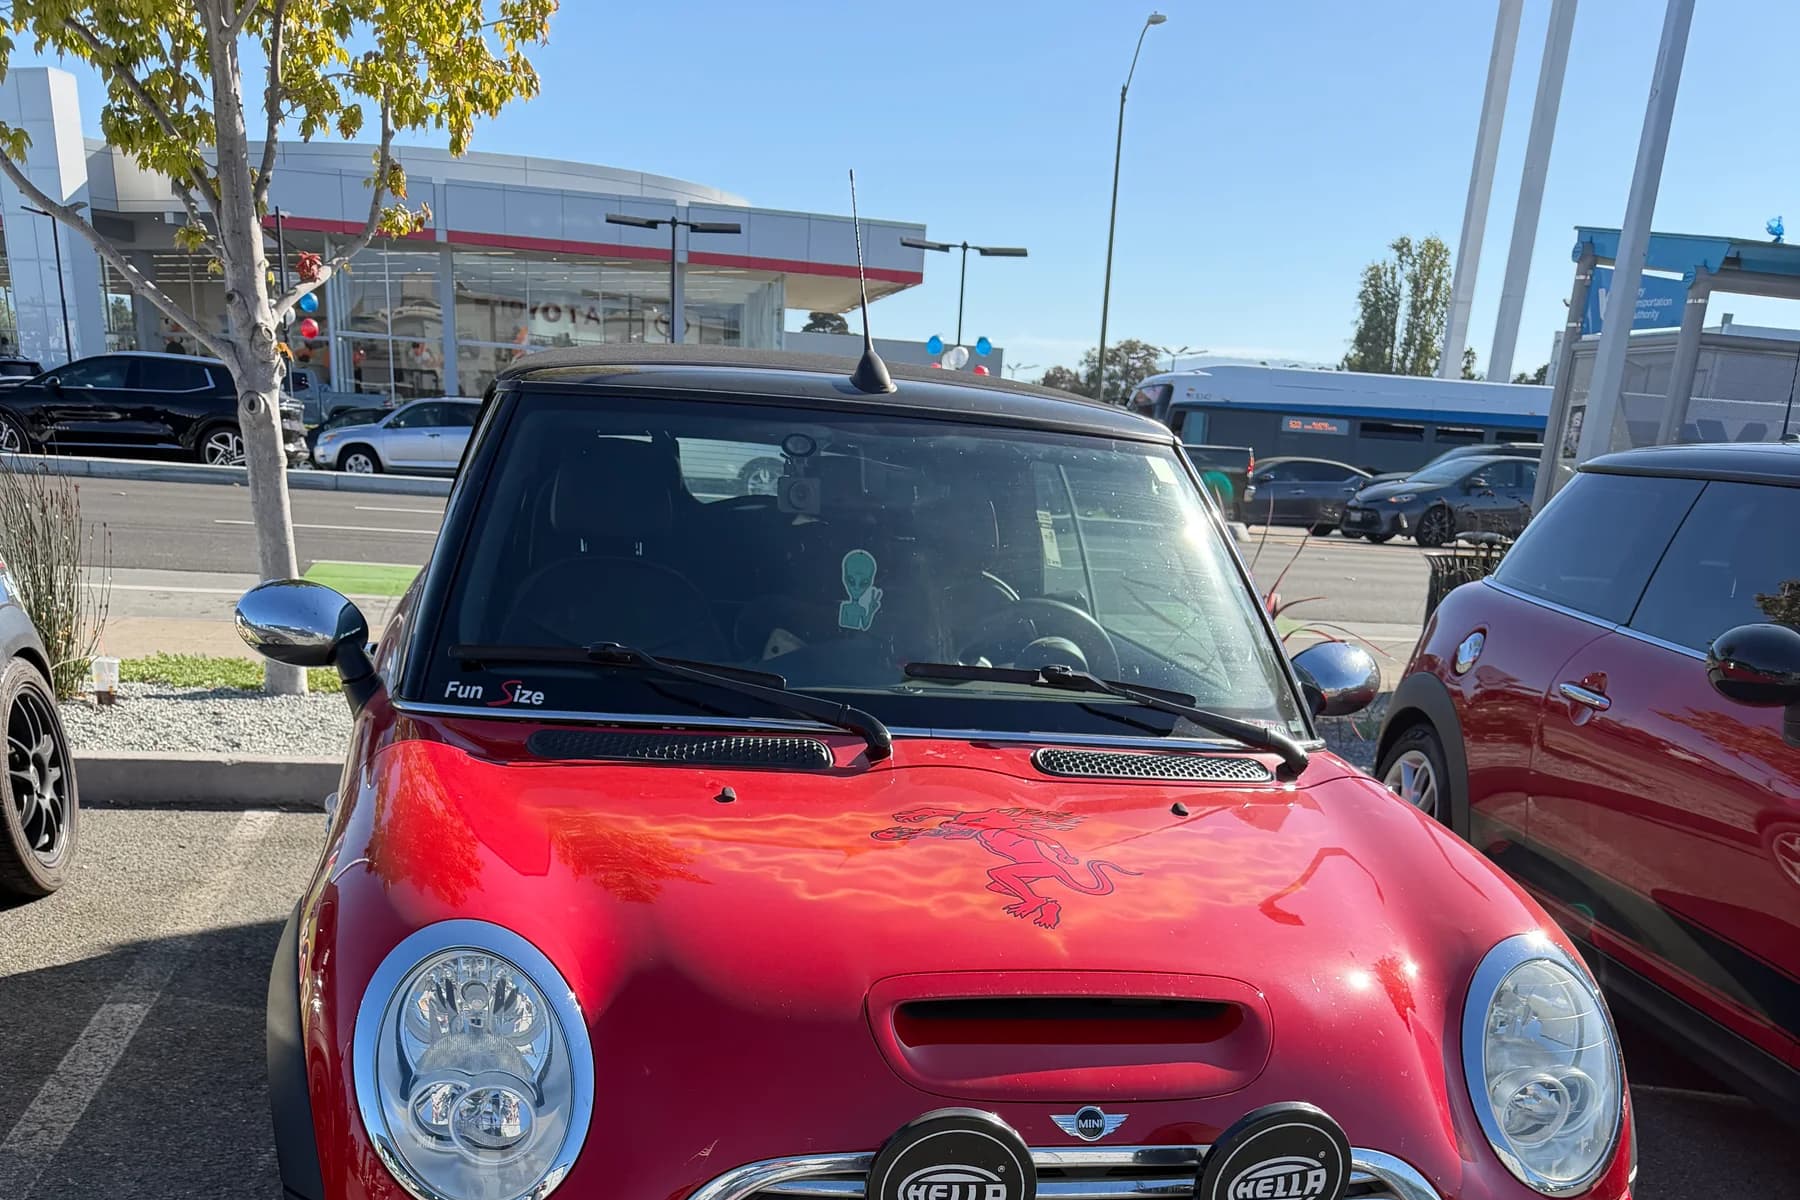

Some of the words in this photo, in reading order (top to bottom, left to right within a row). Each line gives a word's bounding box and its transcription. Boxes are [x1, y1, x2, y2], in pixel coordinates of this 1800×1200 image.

[444, 681, 484, 699] Fun
[486, 680, 545, 706] Size
[1078, 1118, 1103, 1129] MINI
[1236, 1167, 1327, 1200] HELLA
